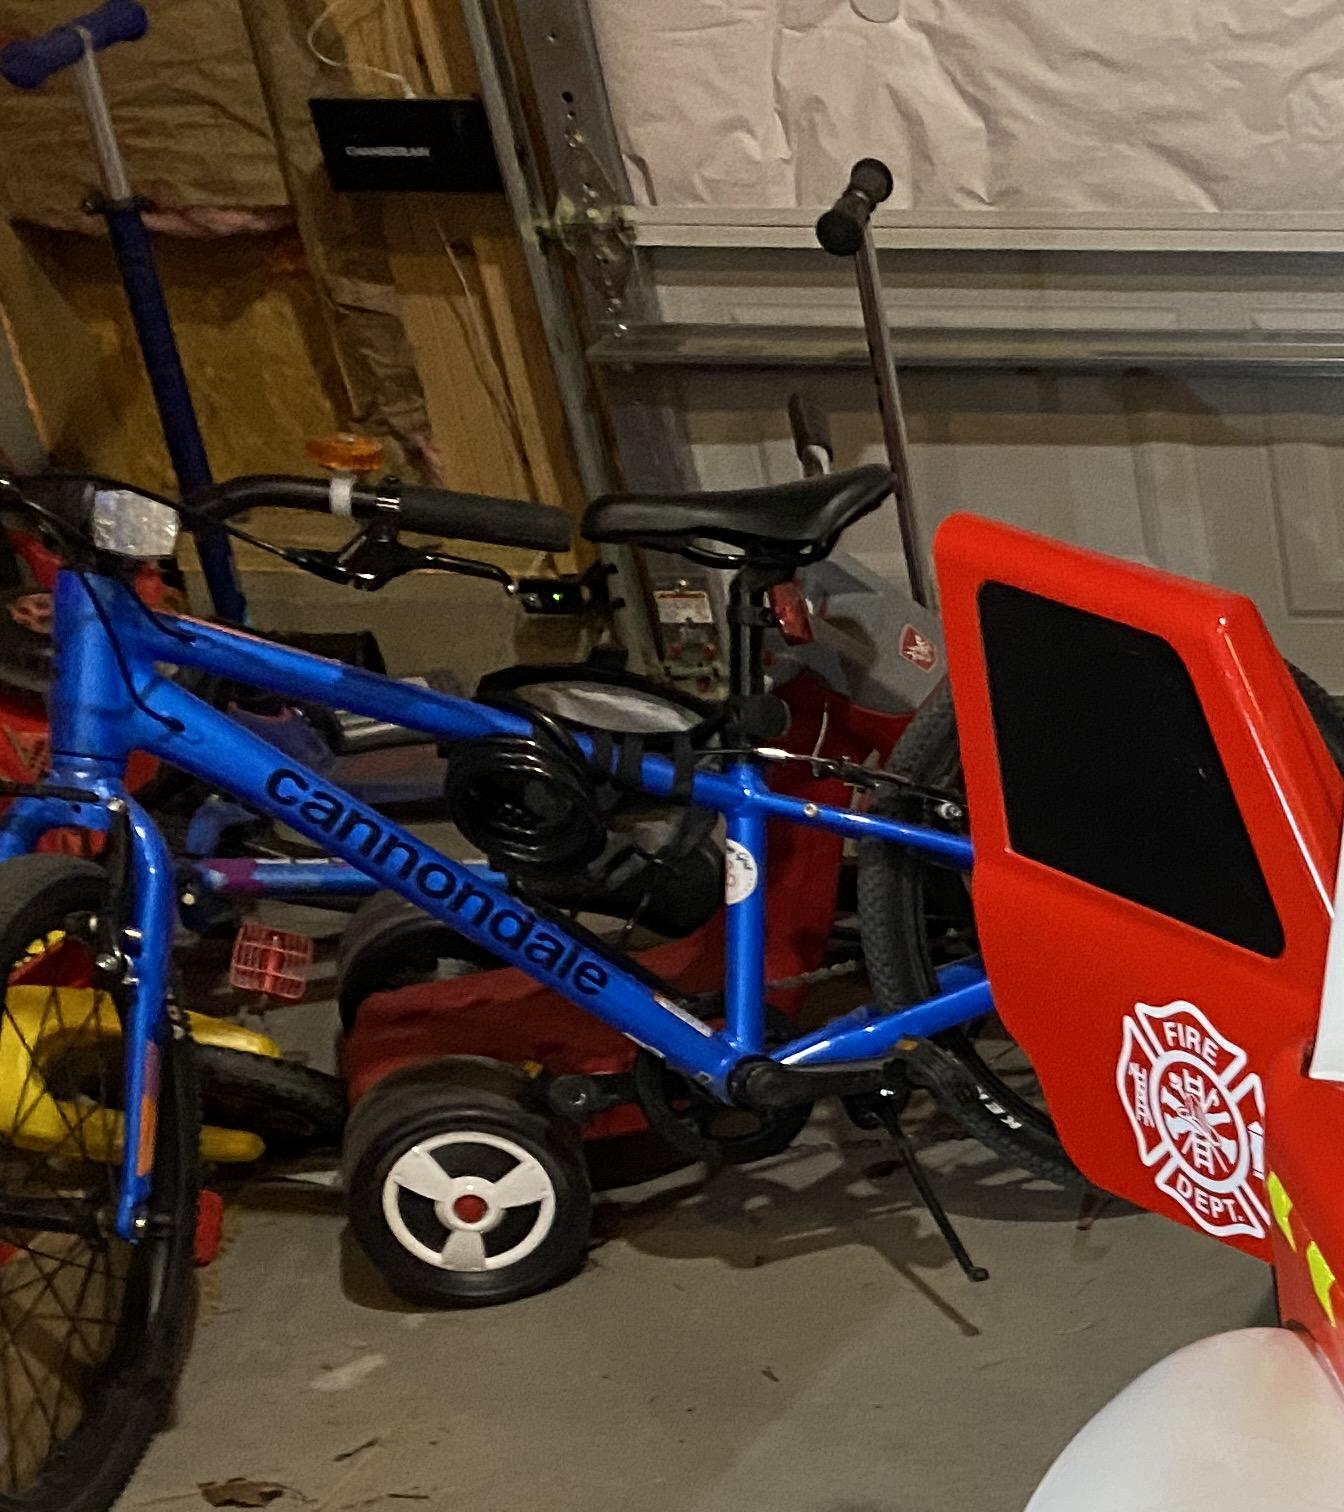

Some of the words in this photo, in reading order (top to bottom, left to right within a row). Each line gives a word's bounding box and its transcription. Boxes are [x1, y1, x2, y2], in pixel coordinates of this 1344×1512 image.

[266, 768, 608, 996] cannondale
[1162, 1021, 1220, 1067] FIRE
[1175, 1174, 1246, 1223] DEPT.
